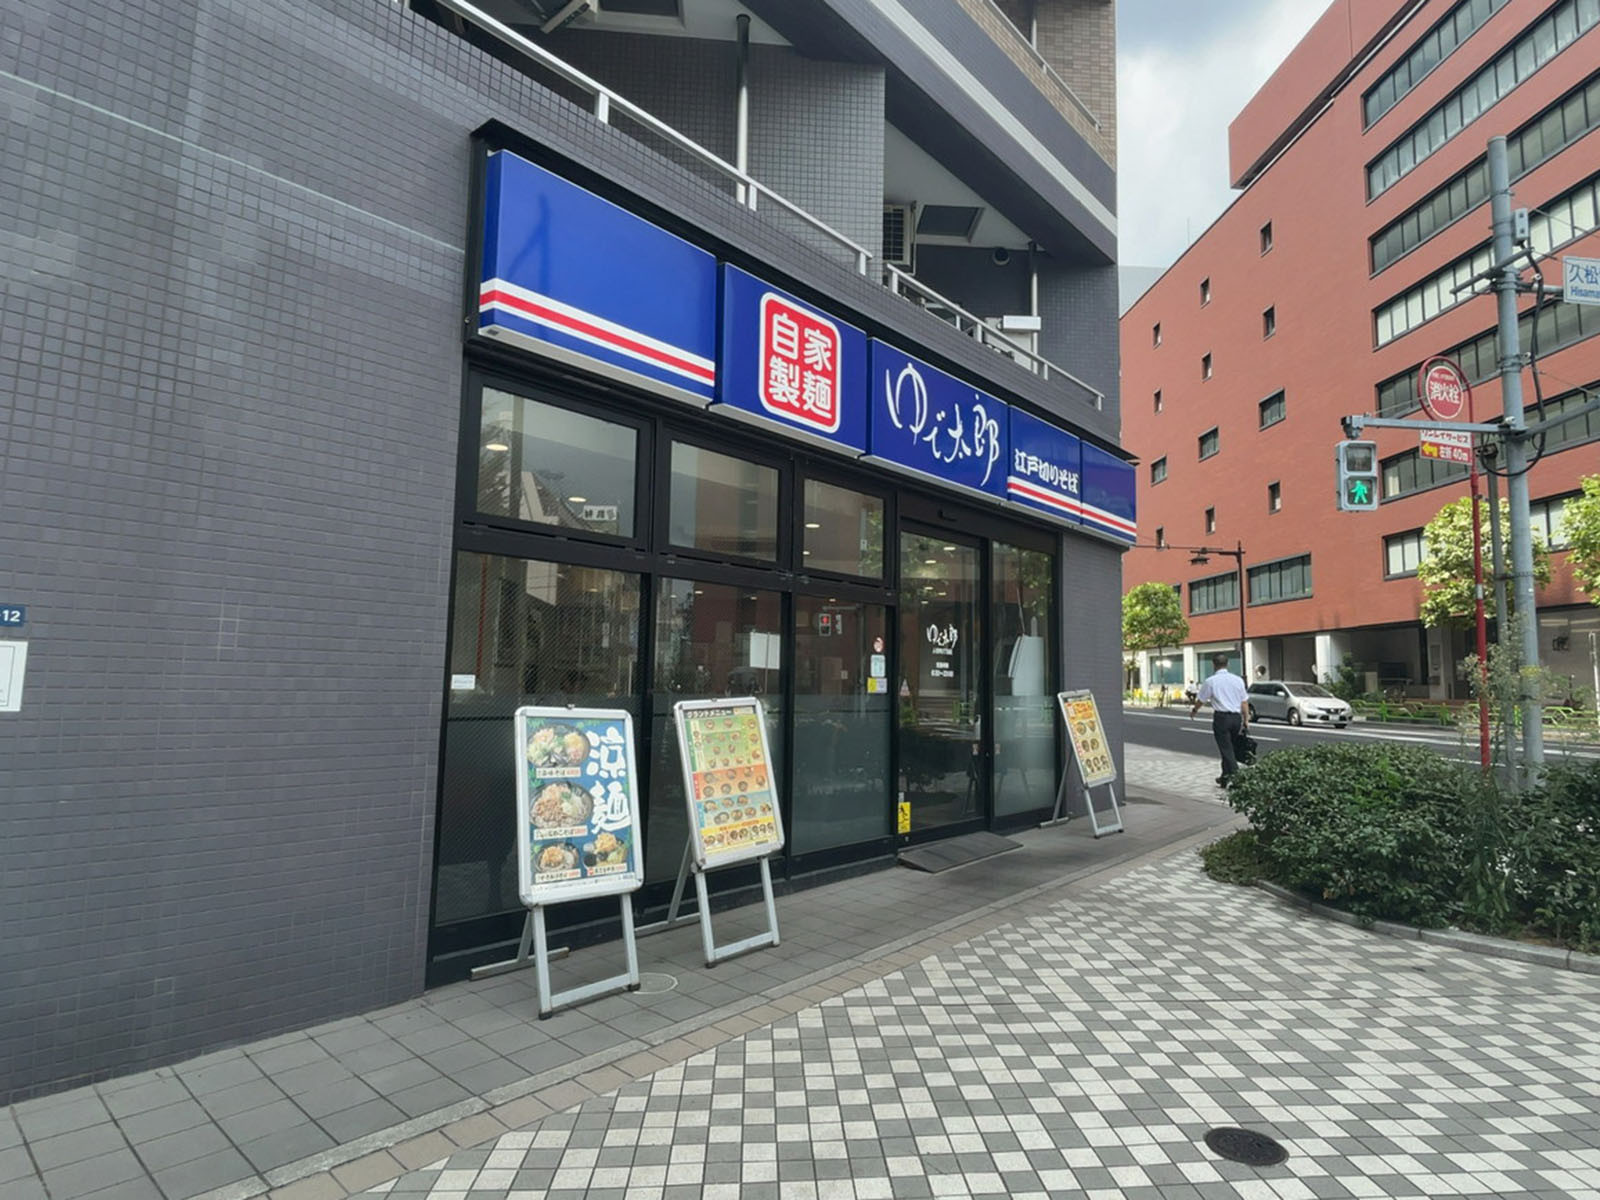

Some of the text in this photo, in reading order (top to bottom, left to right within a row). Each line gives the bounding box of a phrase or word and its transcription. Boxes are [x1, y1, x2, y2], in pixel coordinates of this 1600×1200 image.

[1569, 264, 1600, 285] 久松
[772, 312, 833, 372] 自家
[768, 355, 832, 419] 製麺
[1429, 380, 1461, 404] 消火栓
[885, 362, 1000, 487] ゆで太郎
[1014, 448, 1079, 494] 江戸切りそば
